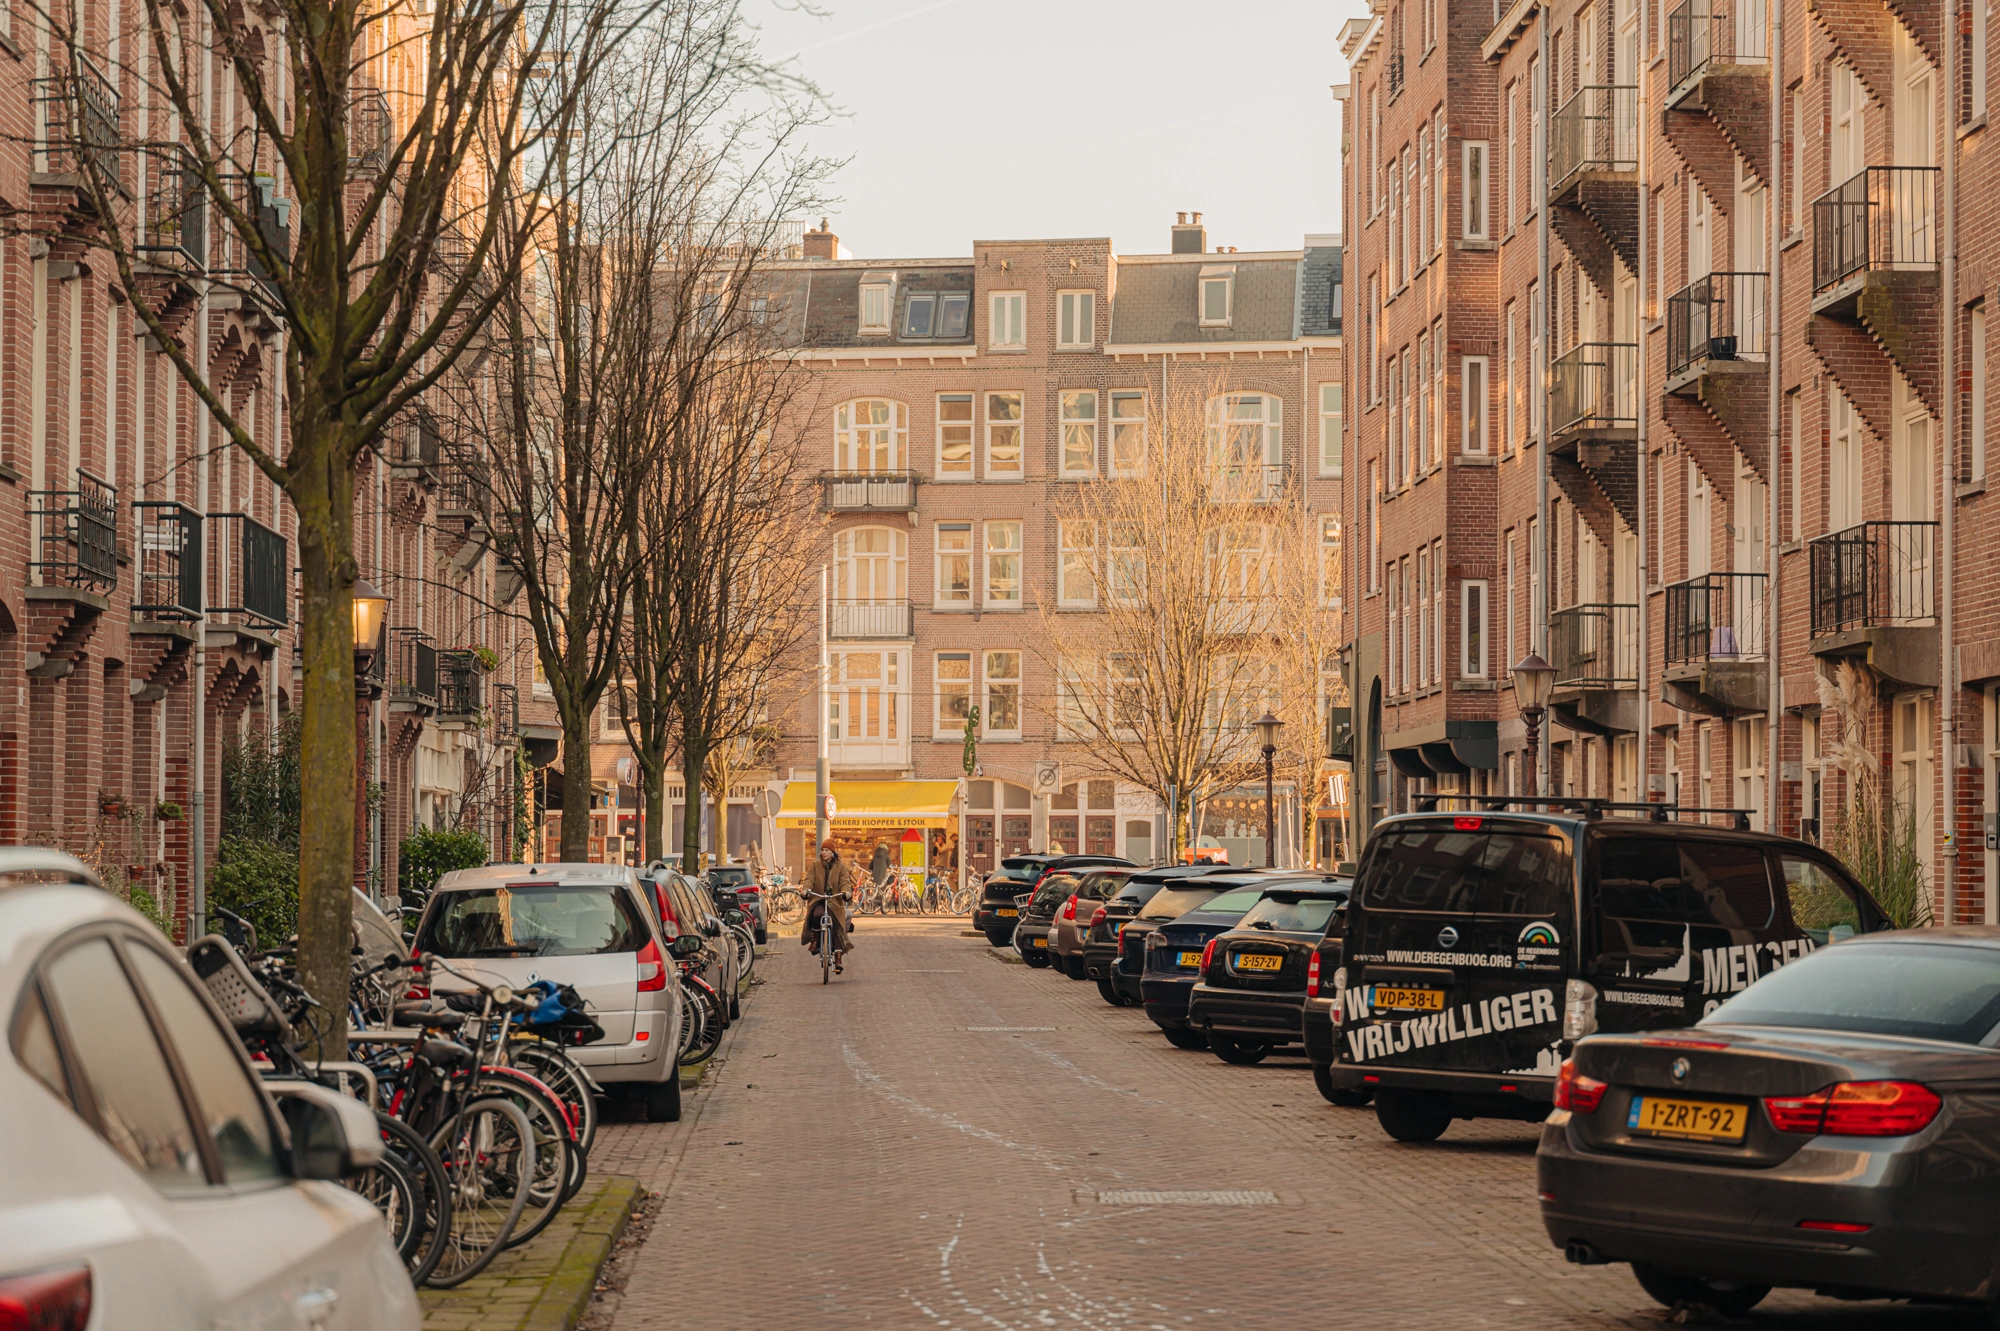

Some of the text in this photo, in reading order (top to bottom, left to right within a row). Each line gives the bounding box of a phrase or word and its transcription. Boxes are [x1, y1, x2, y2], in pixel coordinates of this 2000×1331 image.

[1387, 950, 1512, 968] WWW.DEREGENBOOG.ORG
[1526, 947, 1560, 955] REGENBOOG
[1242, 957, 1278, 968] S-157-ZV
[1379, 990, 1438, 1008] VDP-38-L
[1604, 990, 1685, 1008] WWW.DEREGENBOOG.ORG
[1347, 988, 1557, 1063] VRIJWILLIGER
[1650, 1102, 1735, 1132] 1-ZRT-92
